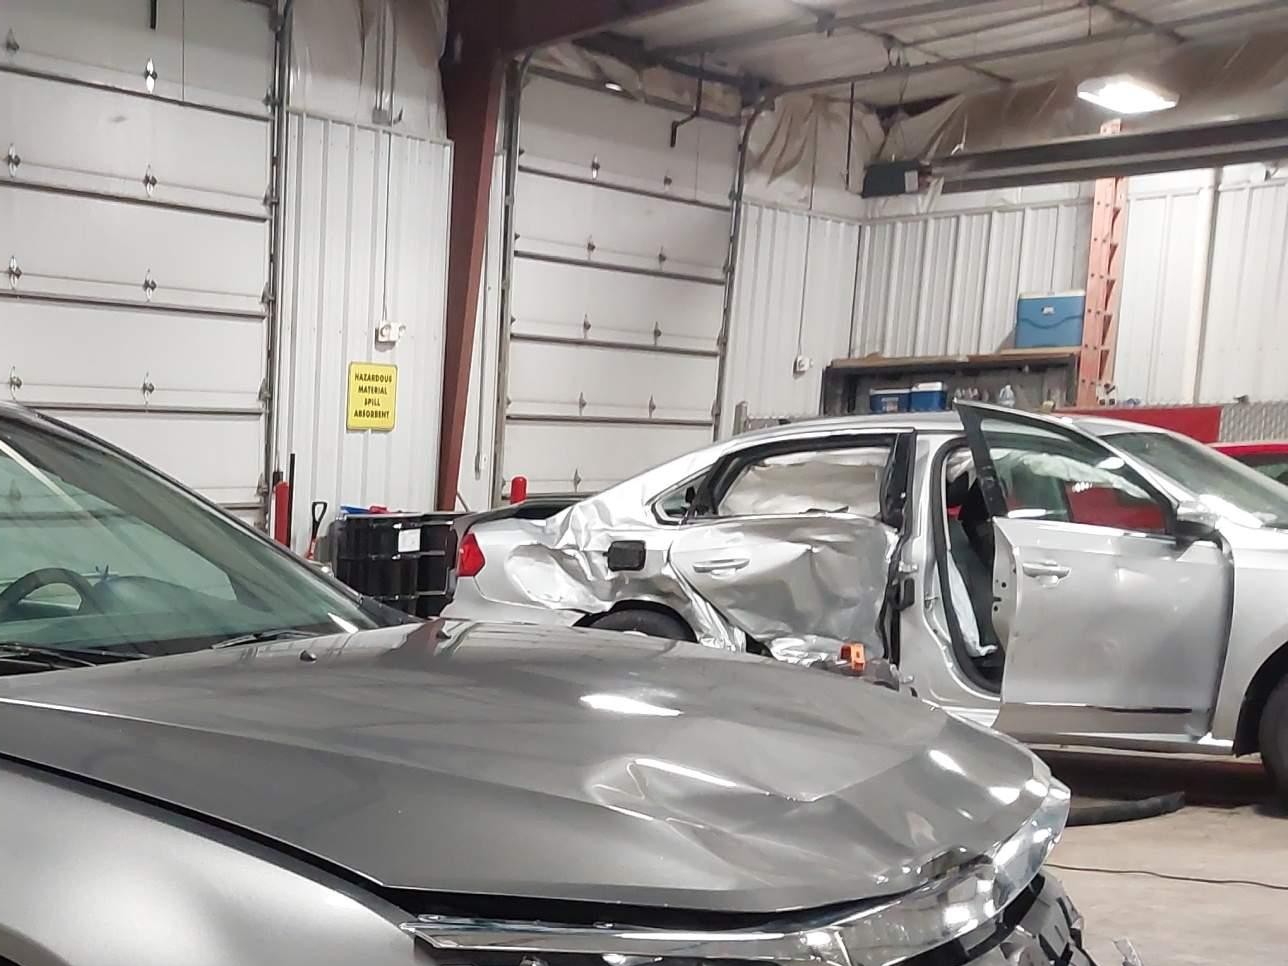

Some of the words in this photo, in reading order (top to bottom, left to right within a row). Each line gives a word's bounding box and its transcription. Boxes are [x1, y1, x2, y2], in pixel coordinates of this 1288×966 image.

[355, 373, 392, 383] HAZARDOUS
[358, 385, 387, 395] MATERIAL
[364, 398, 380, 406] SPILL
[354, 410, 389, 419] ABSORBENT
